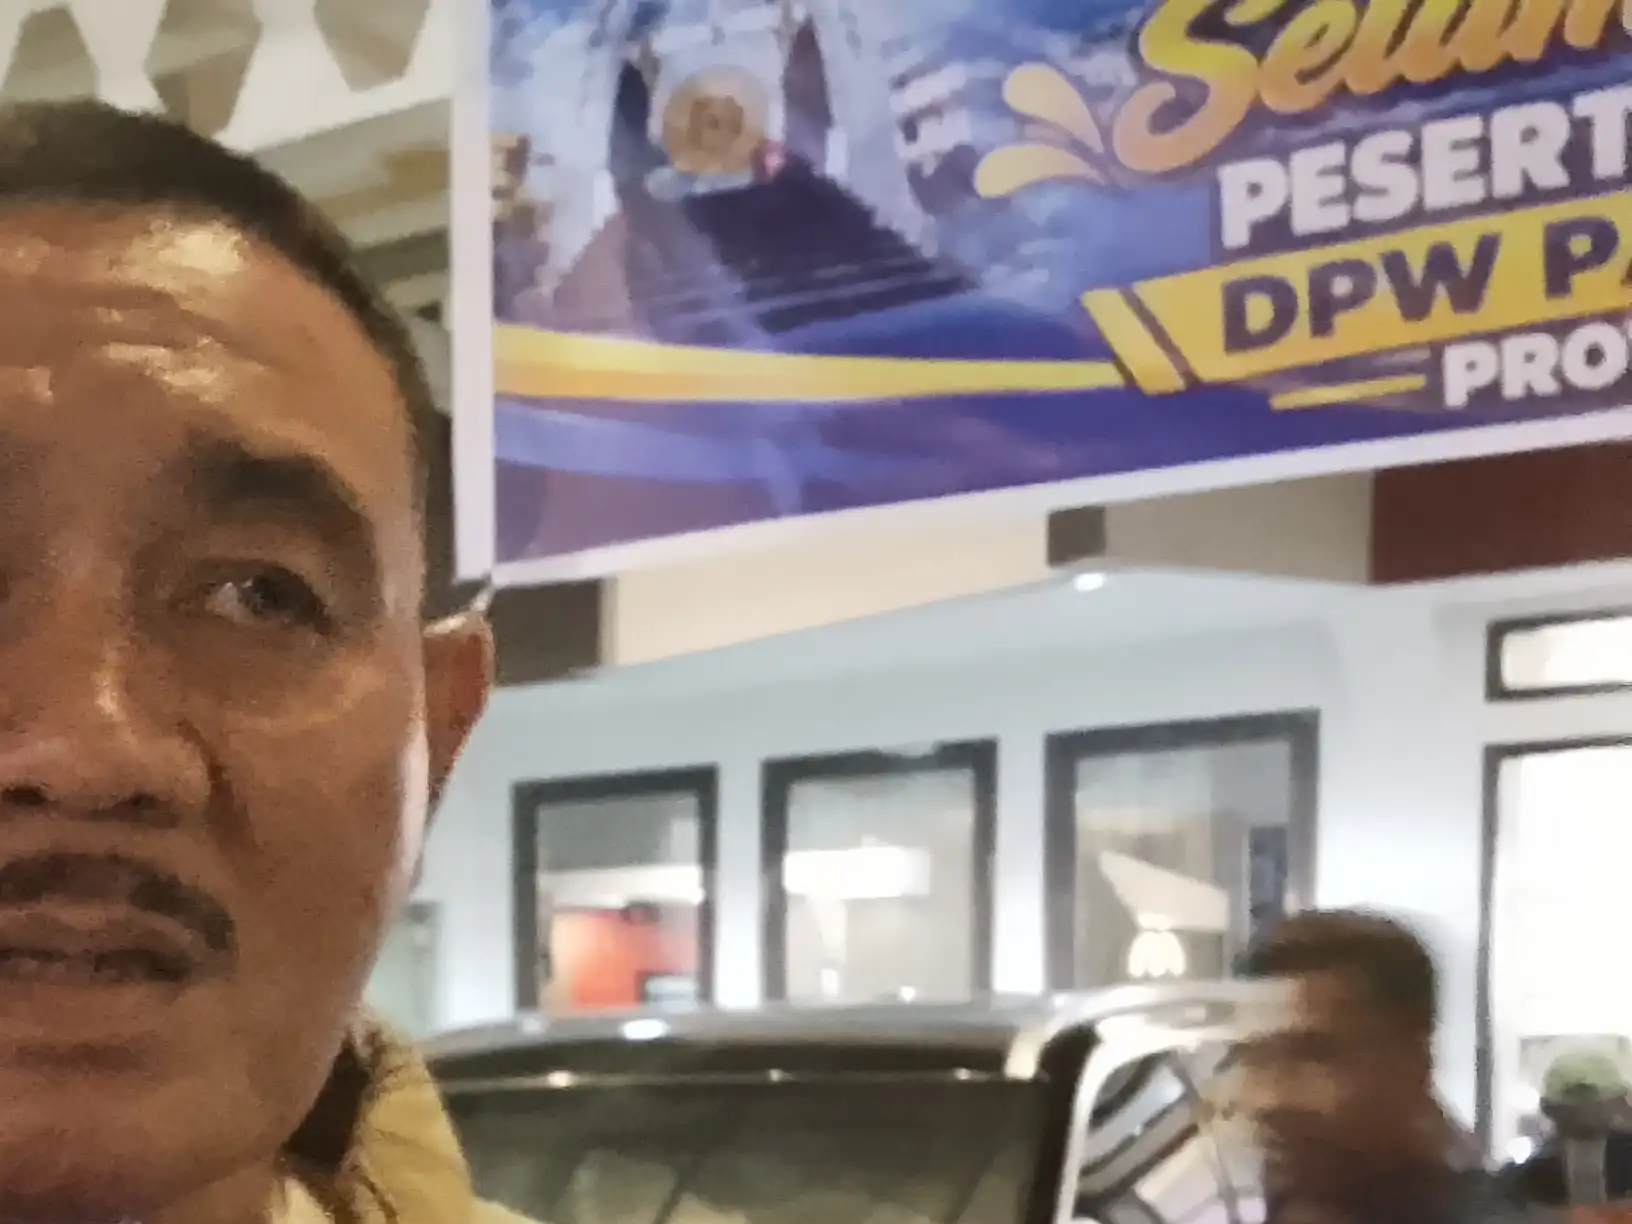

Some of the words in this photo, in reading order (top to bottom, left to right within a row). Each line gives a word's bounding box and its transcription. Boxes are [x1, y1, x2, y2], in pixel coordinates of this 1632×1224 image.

[1217, 84, 1632, 251] PESERT
[1221, 231, 1503, 355] DPW
[1541, 213, 1632, 300] P
[1443, 315, 1632, 410] PRO
